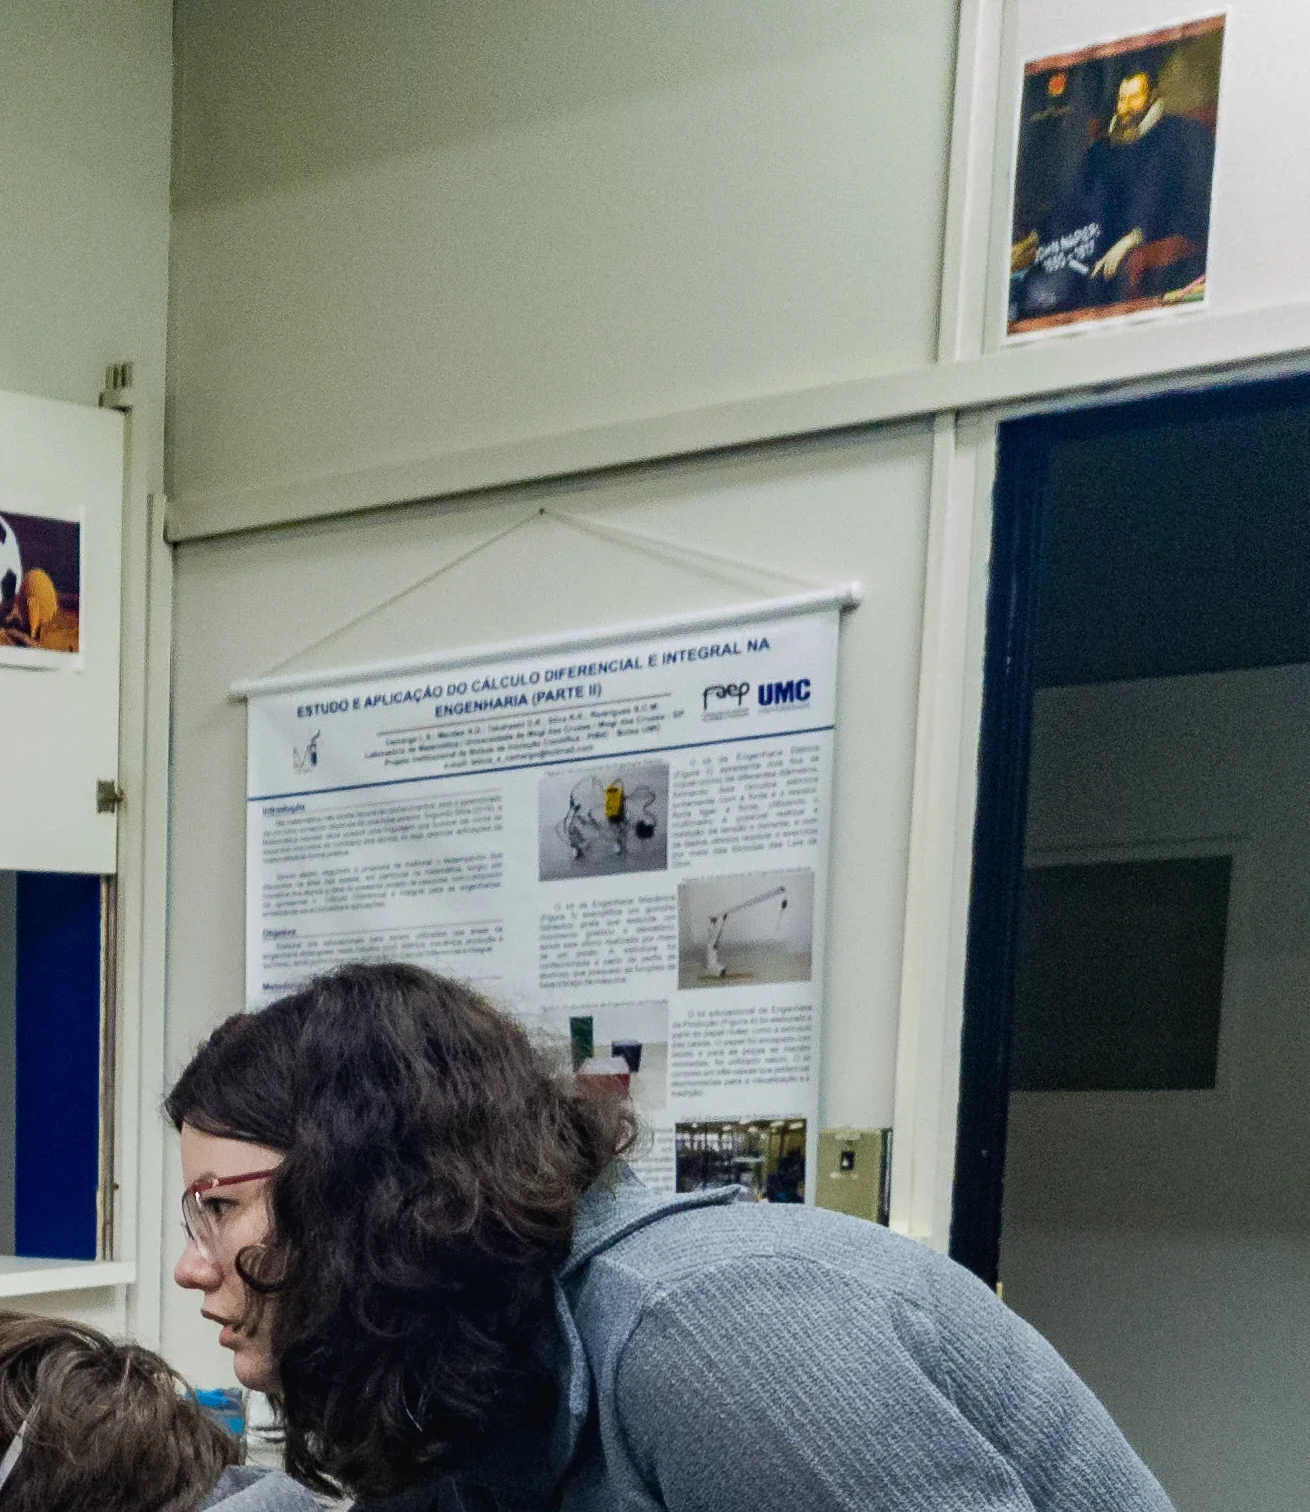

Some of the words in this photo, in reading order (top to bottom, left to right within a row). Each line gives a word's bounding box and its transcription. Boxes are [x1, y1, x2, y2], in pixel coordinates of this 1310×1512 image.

[296, 699, 349, 718] ESTUDO
[352, 696, 361, 711] E
[364, 683, 444, 709] APLICAÇÃO
[446, 681, 468, 697] DO
[471, 667, 541, 694] CÁLCULO
[544, 654, 643, 683] DIFERENCIAL
[648, 654, 658, 668] E
[662, 641, 742, 666] INTEGRAL
[747, 636, 771, 652] NA
[758, 678, 811, 706] UMC
[434, 692, 529, 718] ENGENHARIA
[532, 685, 583, 706] (PARTE
